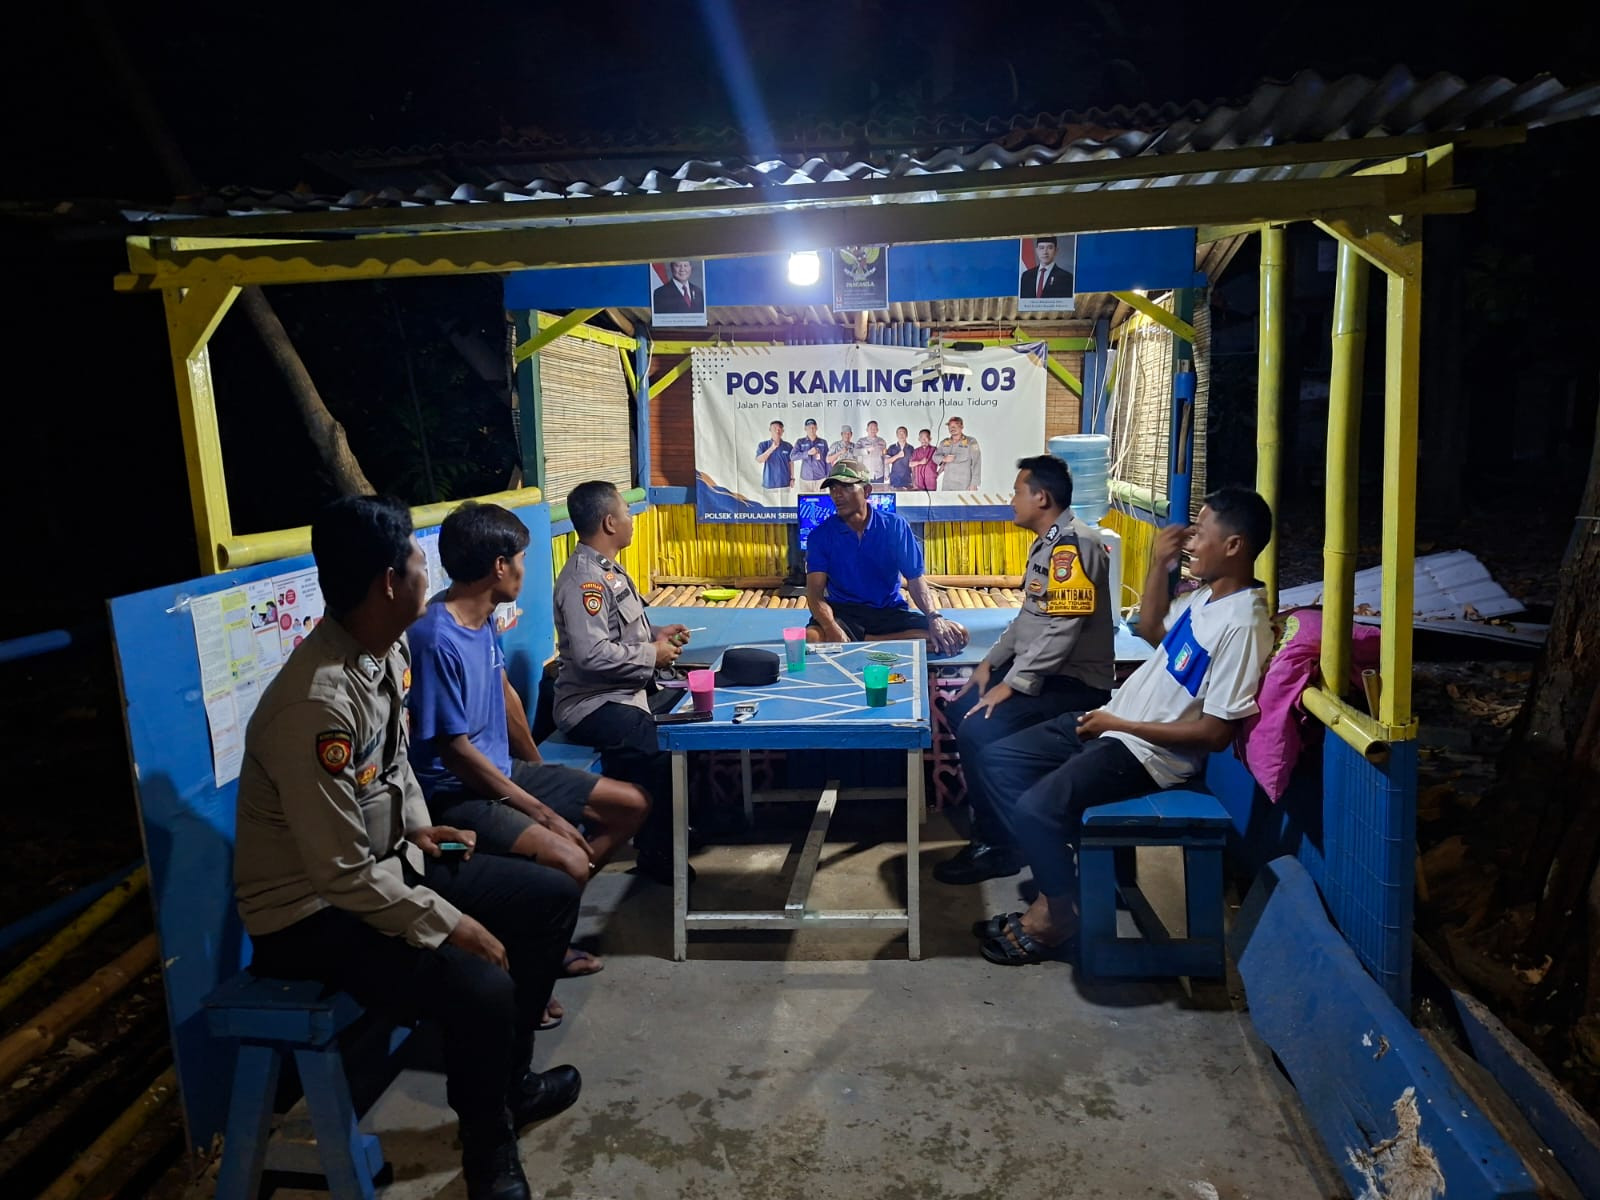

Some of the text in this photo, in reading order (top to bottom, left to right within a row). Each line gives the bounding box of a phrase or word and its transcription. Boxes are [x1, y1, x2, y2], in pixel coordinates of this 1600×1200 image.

[726, 367, 1016, 395] POS KAMLING RW. 03
[737, 400, 759, 409] Jalan
[762, 400, 788, 409] Pantai
[792, 400, 823, 408] Selatan
[843, 399, 853, 407] 01
[876, 399, 888, 407] 03
[890, 398, 936, 407] Kelurahan
[939, 398, 964, 407] Pulau
[967, 397, 998, 407] Tidung
